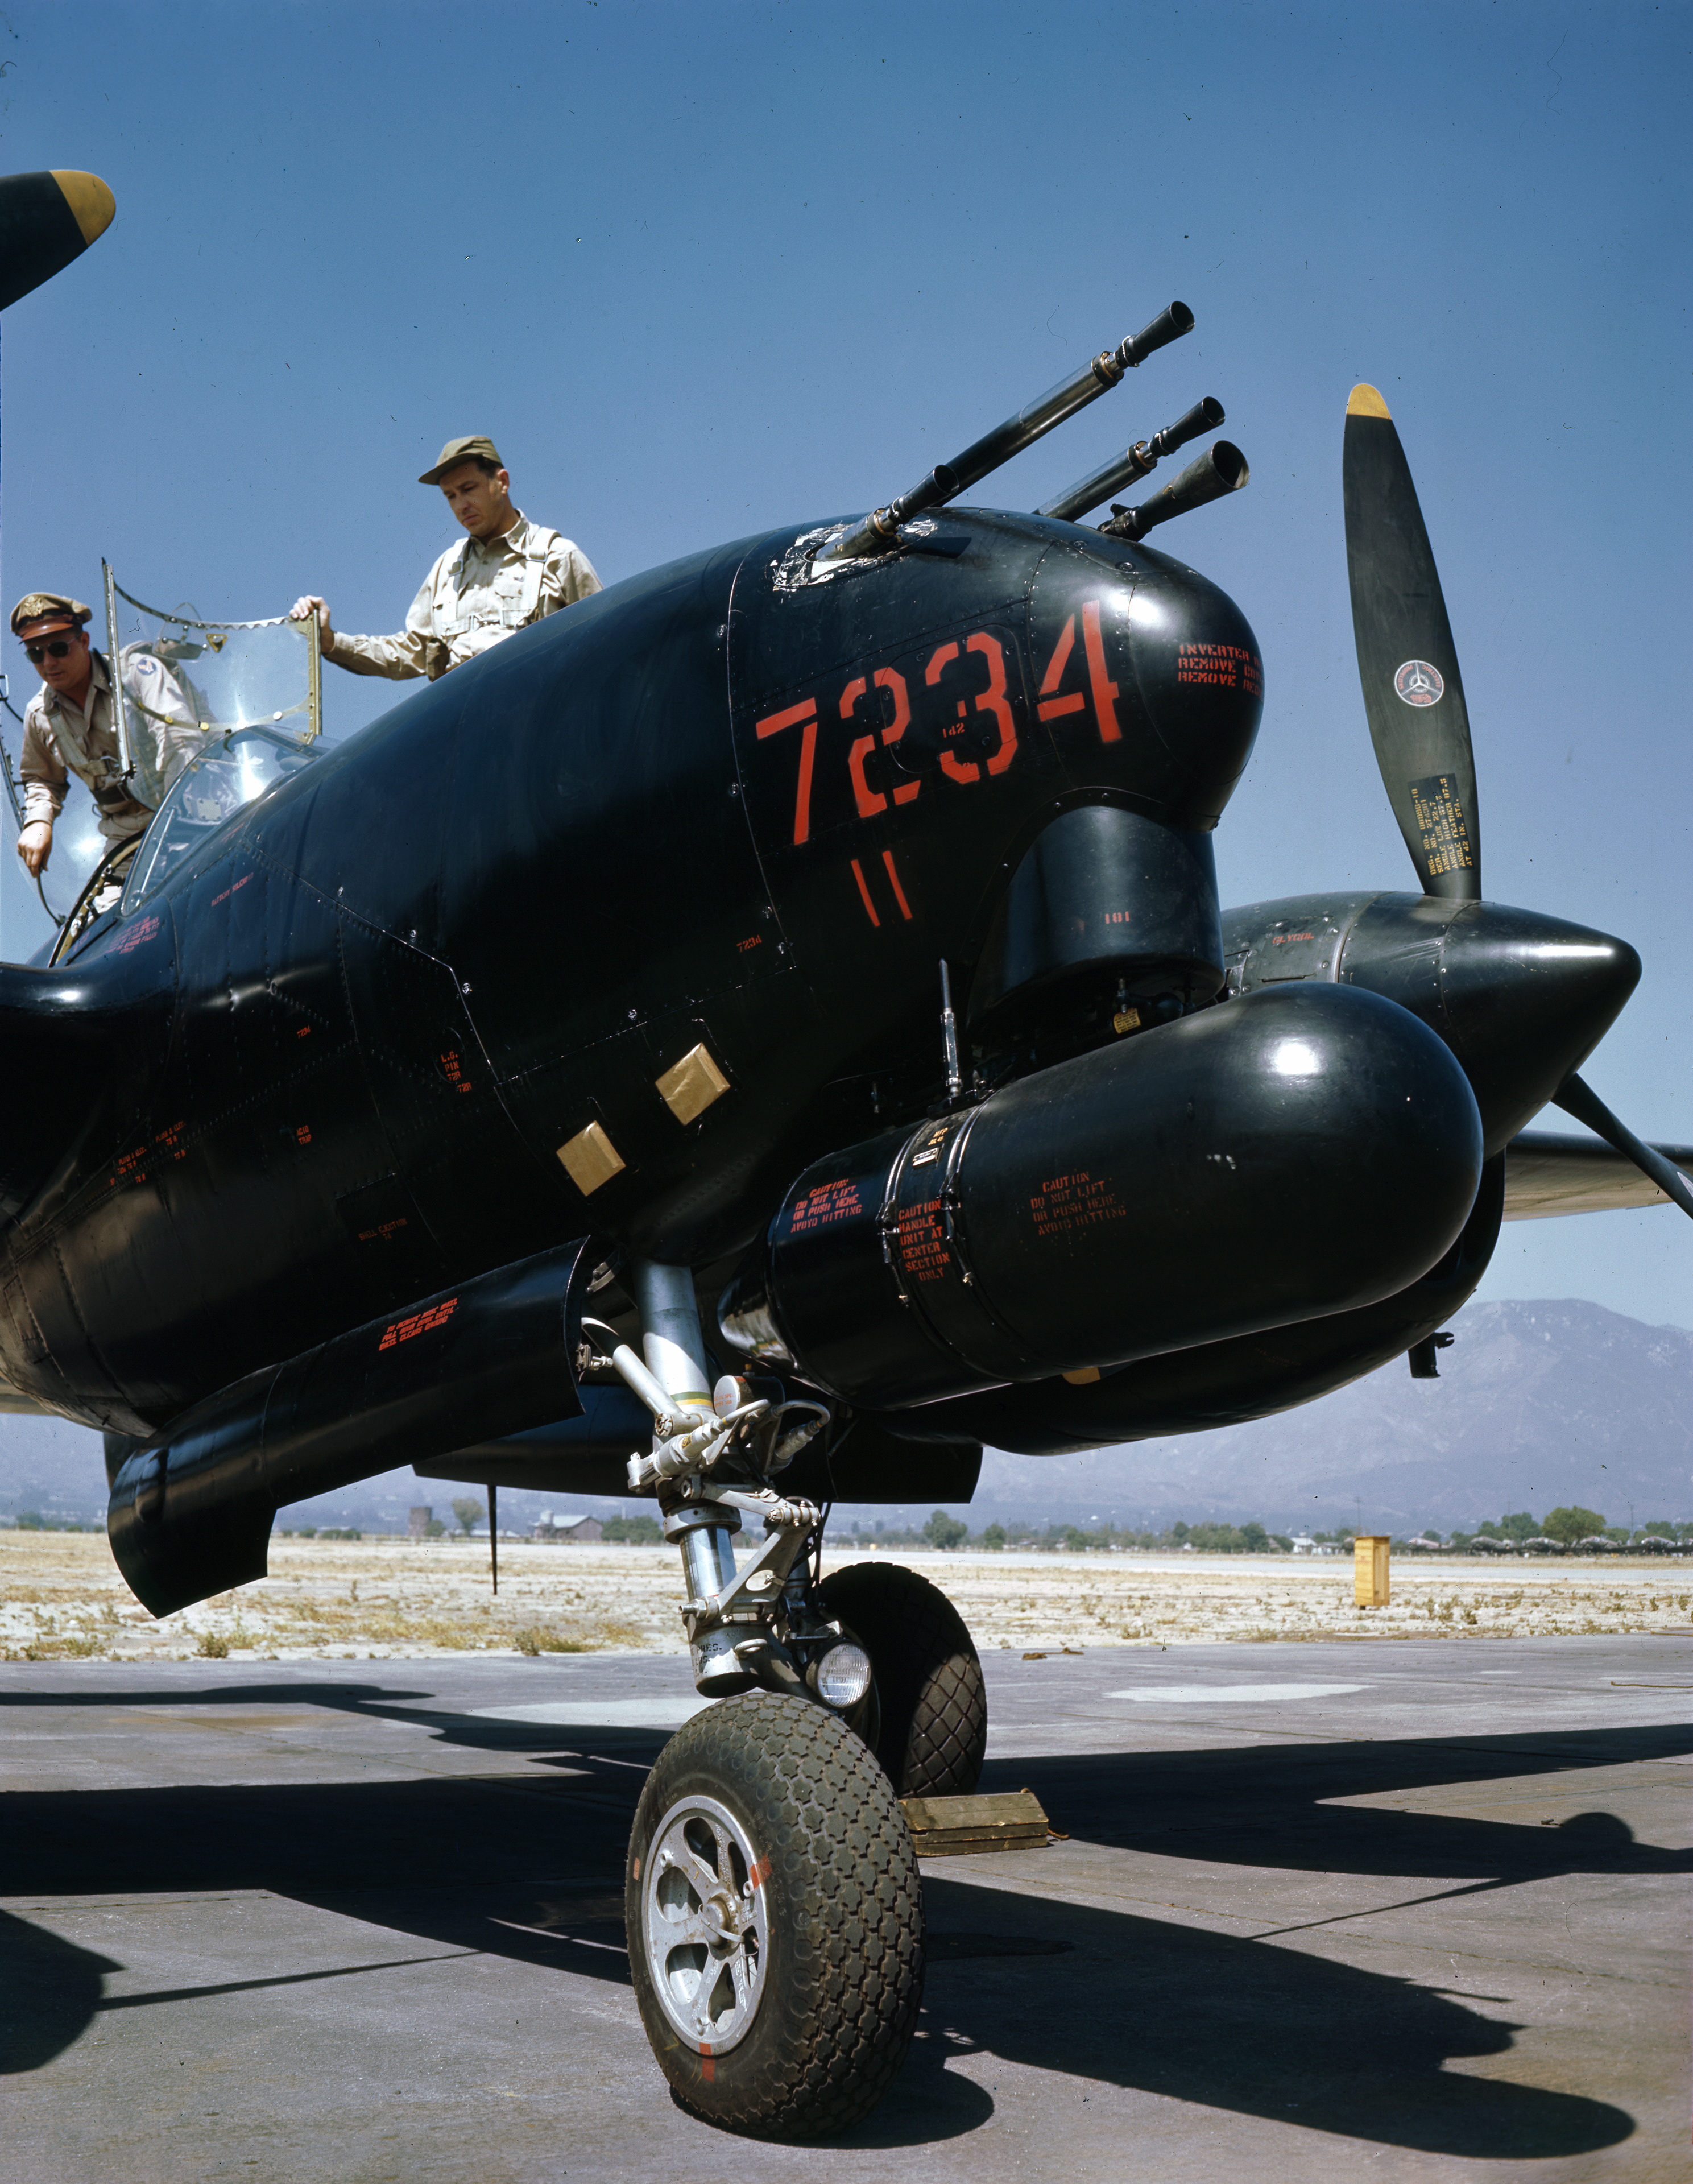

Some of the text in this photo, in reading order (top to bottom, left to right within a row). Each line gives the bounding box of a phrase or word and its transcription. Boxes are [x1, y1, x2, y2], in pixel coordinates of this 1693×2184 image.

[1179, 644, 1250, 661] INVERTER
[1178, 657, 1236, 672] REMOVE
[1178, 671, 1236, 687] REMOVE
[756, 599, 1122, 846] 7234
[942, 722, 965, 738] 142
[1441, 819, 1451, 839] HIGH
[1445, 802, 1459, 838] FEATHER
[1429, 802, 1451, 870] ANGLE LOW 22.7
[1435, 854, 1444, 873] SER.
[1447, 844, 1459, 868] ANGLE
[1455, 842, 1466, 867] ANGLE
[1465, 855, 1473, 866] AT
[1427, 855, 1437, 875] DWG.
[1105, 911, 1129, 924] 181
[1272, 932, 1315, 944] GLYCOL
[444, 1061, 459, 1072] PIN
[296, 1125, 309, 1136] ACID
[809, 1178, 849, 1198] CAUTION
[1042, 1171, 1090, 1193] CAUTION
[795, 1185, 856, 1211] DO NOT LIFT
[1030, 1180, 1104, 1209] DO NOT LIFT
[793, 1193, 859, 1221] OR PUSH HERE
[822, 1203, 862, 1223] HITTING
[899, 1199, 941, 1221] CAUTION
[1032, 1193, 1117, 1222] OR PUSH HERE
[899, 1214, 936, 1234] HANDLE
[1038, 1205, 1127, 1236] AVOID HITTING
[900, 1226, 943, 1246] UNIT AT
[903, 1241, 941, 1259] CENTER
[905, 1251, 950, 1272] SECTION
[918, 1267, 944, 1281] ONLY
